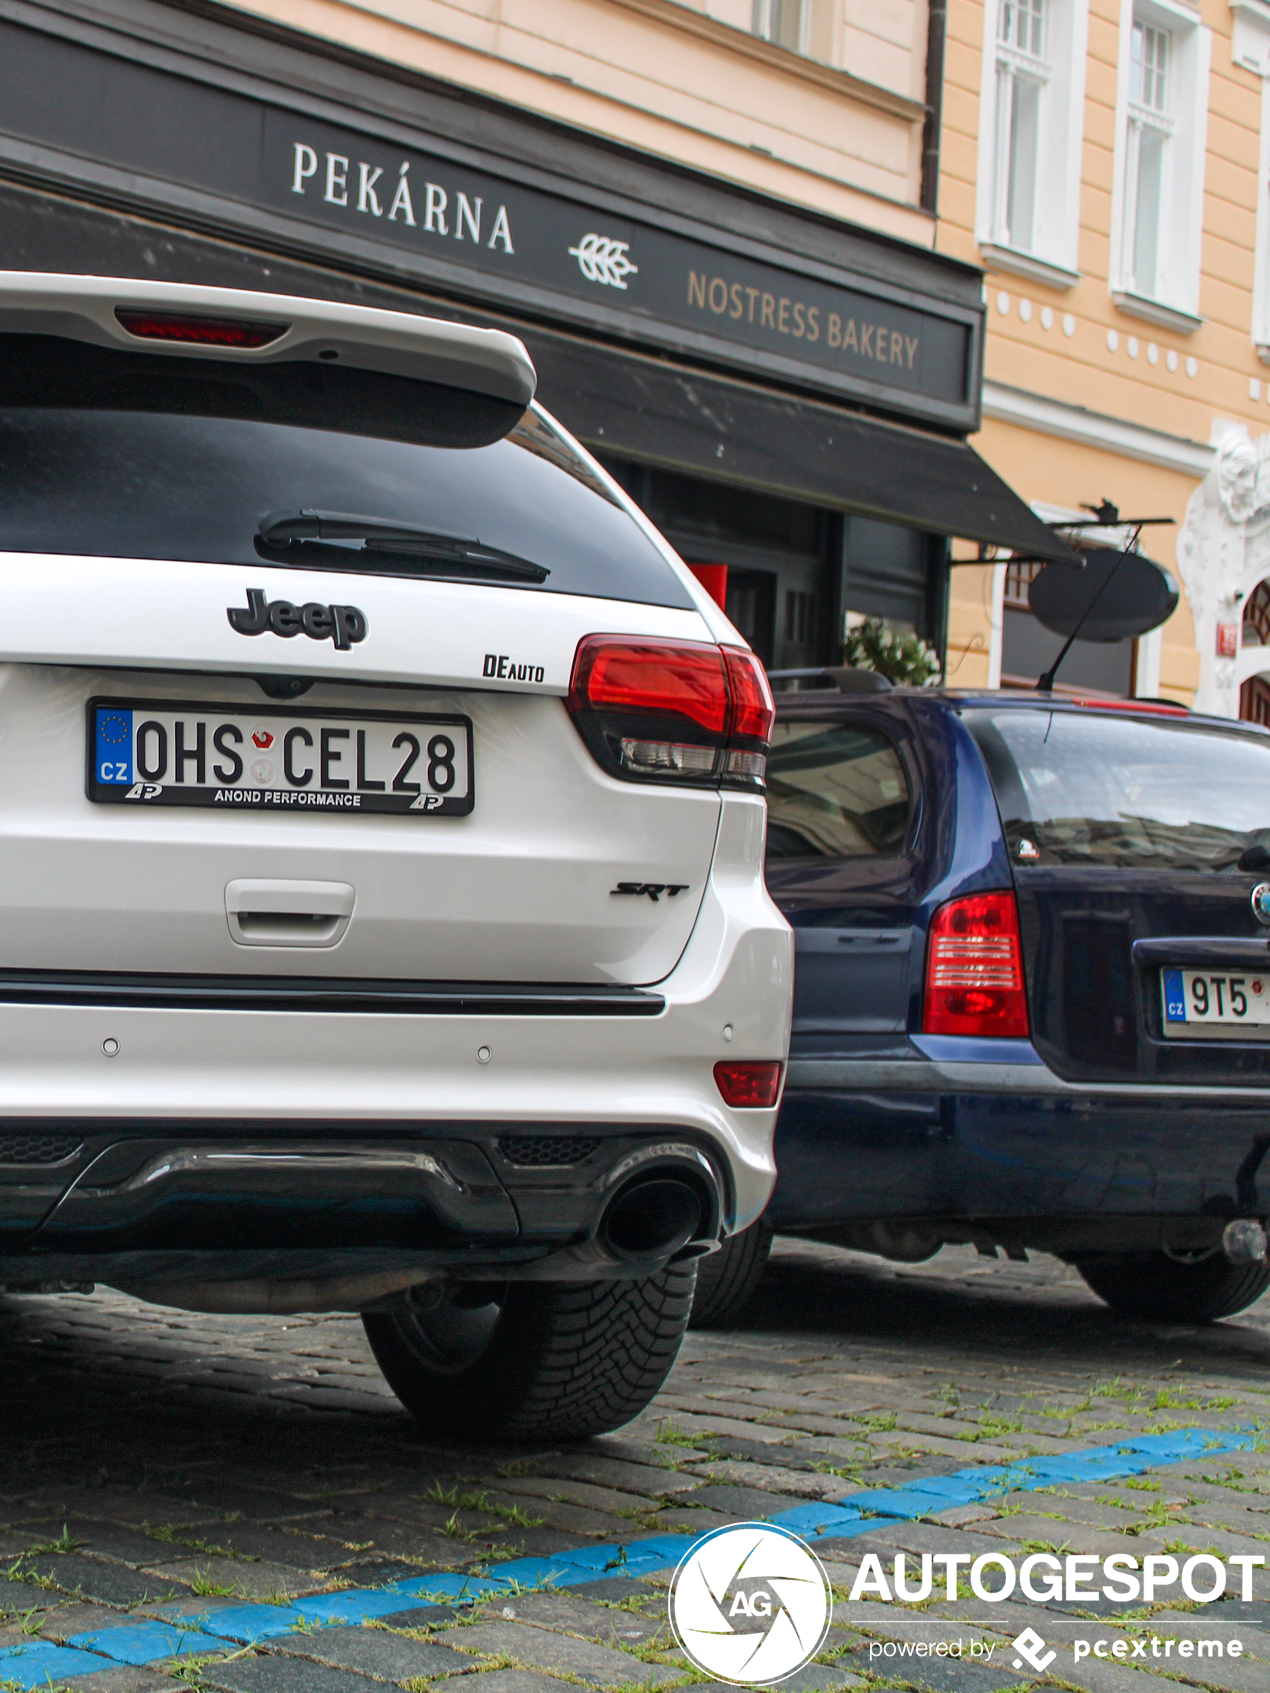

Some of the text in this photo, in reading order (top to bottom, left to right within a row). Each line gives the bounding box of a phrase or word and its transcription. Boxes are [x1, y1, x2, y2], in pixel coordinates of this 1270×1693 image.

[291, 142, 515, 255] PEKÁRNA
[687, 269, 919, 370] NOSTRESS BAKERY
[226, 588, 368, 651] Jeep
[101, 762, 128, 781] CZ
[283, 726, 456, 793] CEL28
[214, 789, 361, 807] ANOND PERFORMANCE
[610, 882, 690, 901] SRT
[1168, 1002, 1184, 1016] CZ
[1191, 976, 1248, 1017] 9T5
